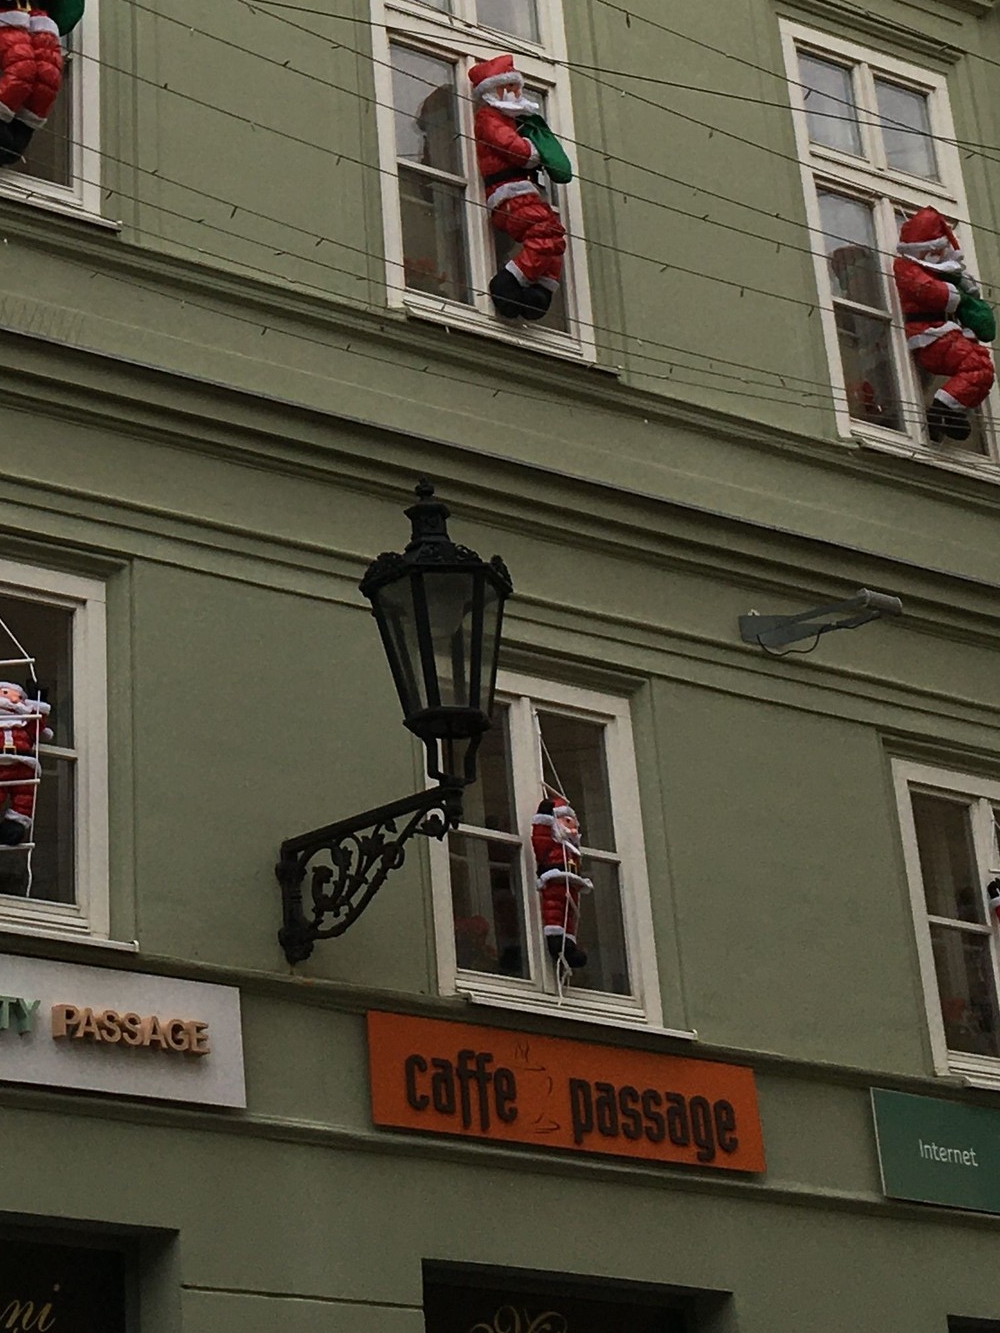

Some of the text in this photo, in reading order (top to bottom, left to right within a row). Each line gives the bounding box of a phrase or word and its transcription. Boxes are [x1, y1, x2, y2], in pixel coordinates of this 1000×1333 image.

[51, 1002, 211, 1056] PASSAGE
[404, 1048, 739, 1163] caffe passage
[918, 1138, 980, 1168] Internet
